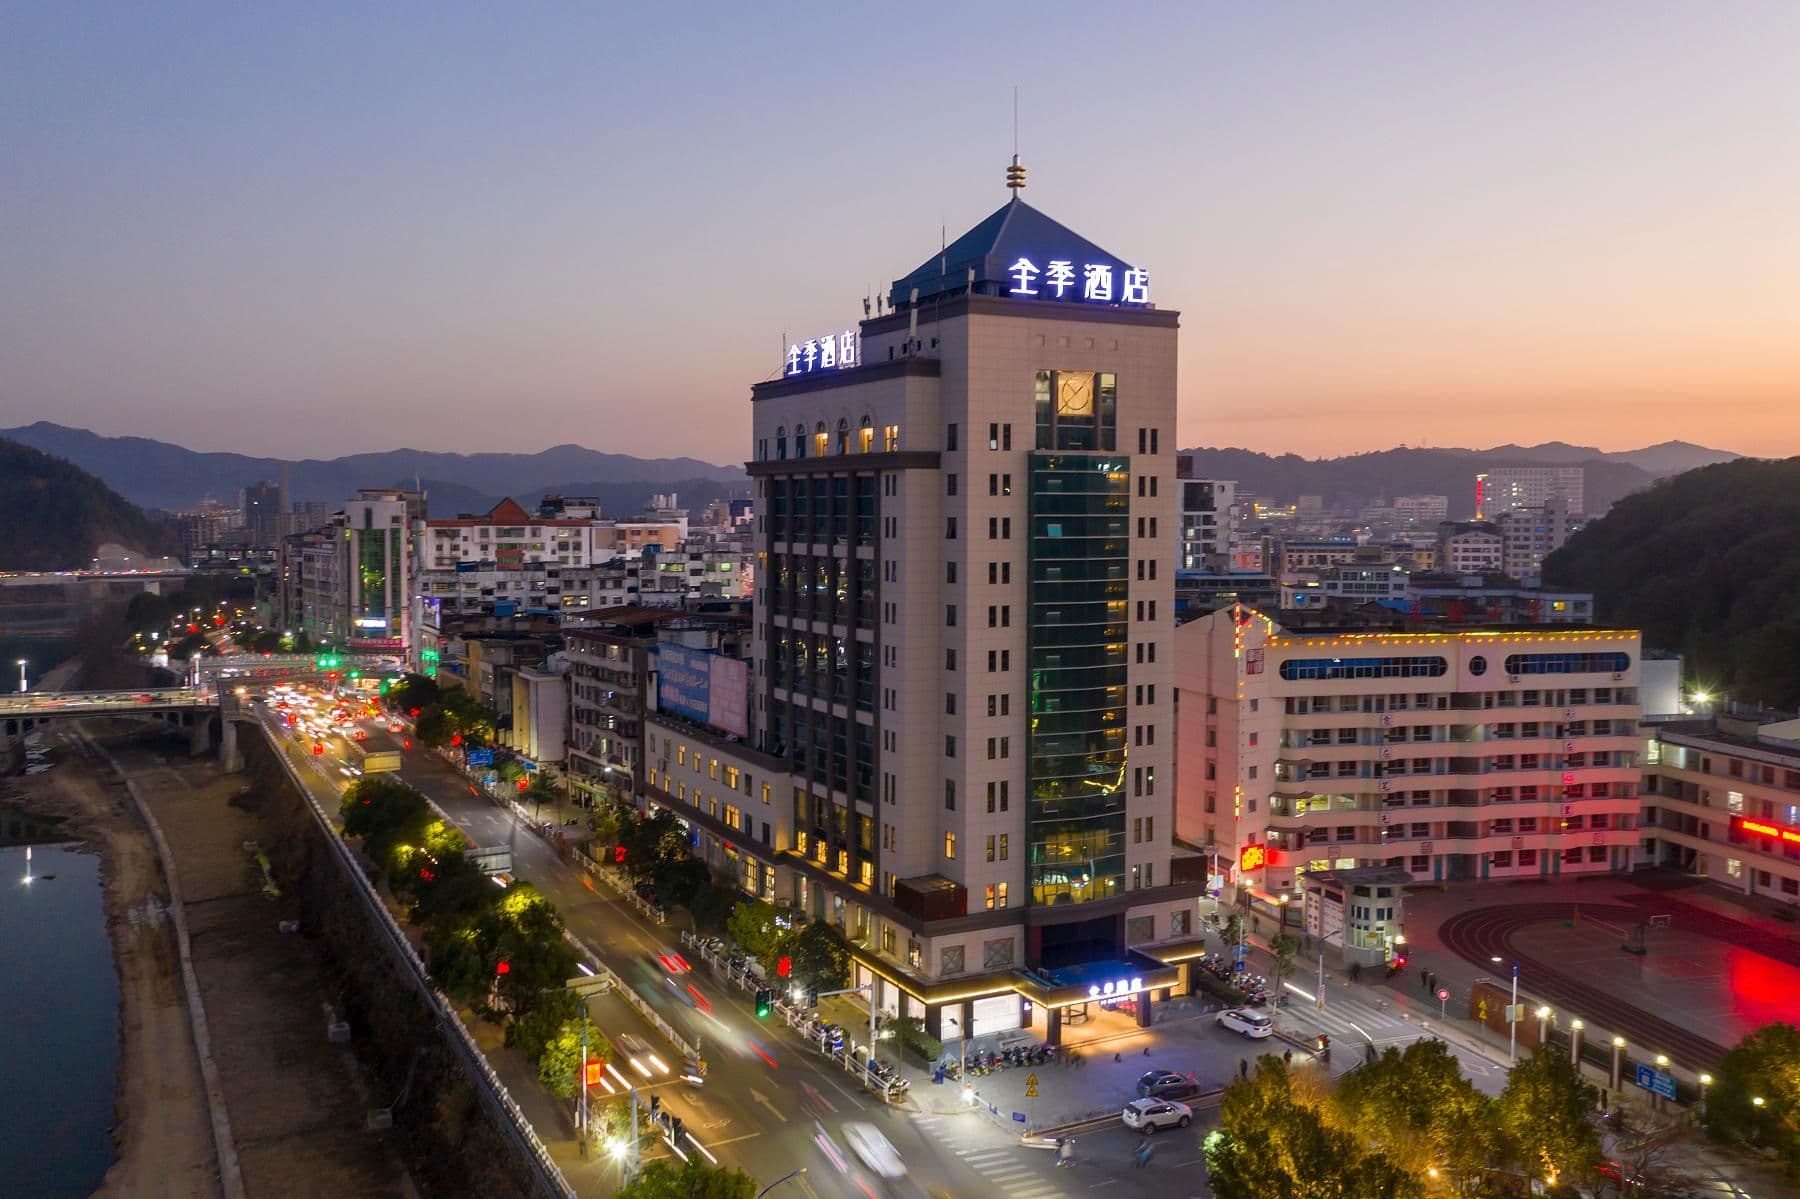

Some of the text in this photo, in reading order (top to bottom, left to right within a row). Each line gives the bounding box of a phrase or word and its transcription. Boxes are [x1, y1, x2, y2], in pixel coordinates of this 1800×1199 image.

[1008, 257, 1149, 303] 全季酒店
[787, 330, 856, 375] 全季酒店
